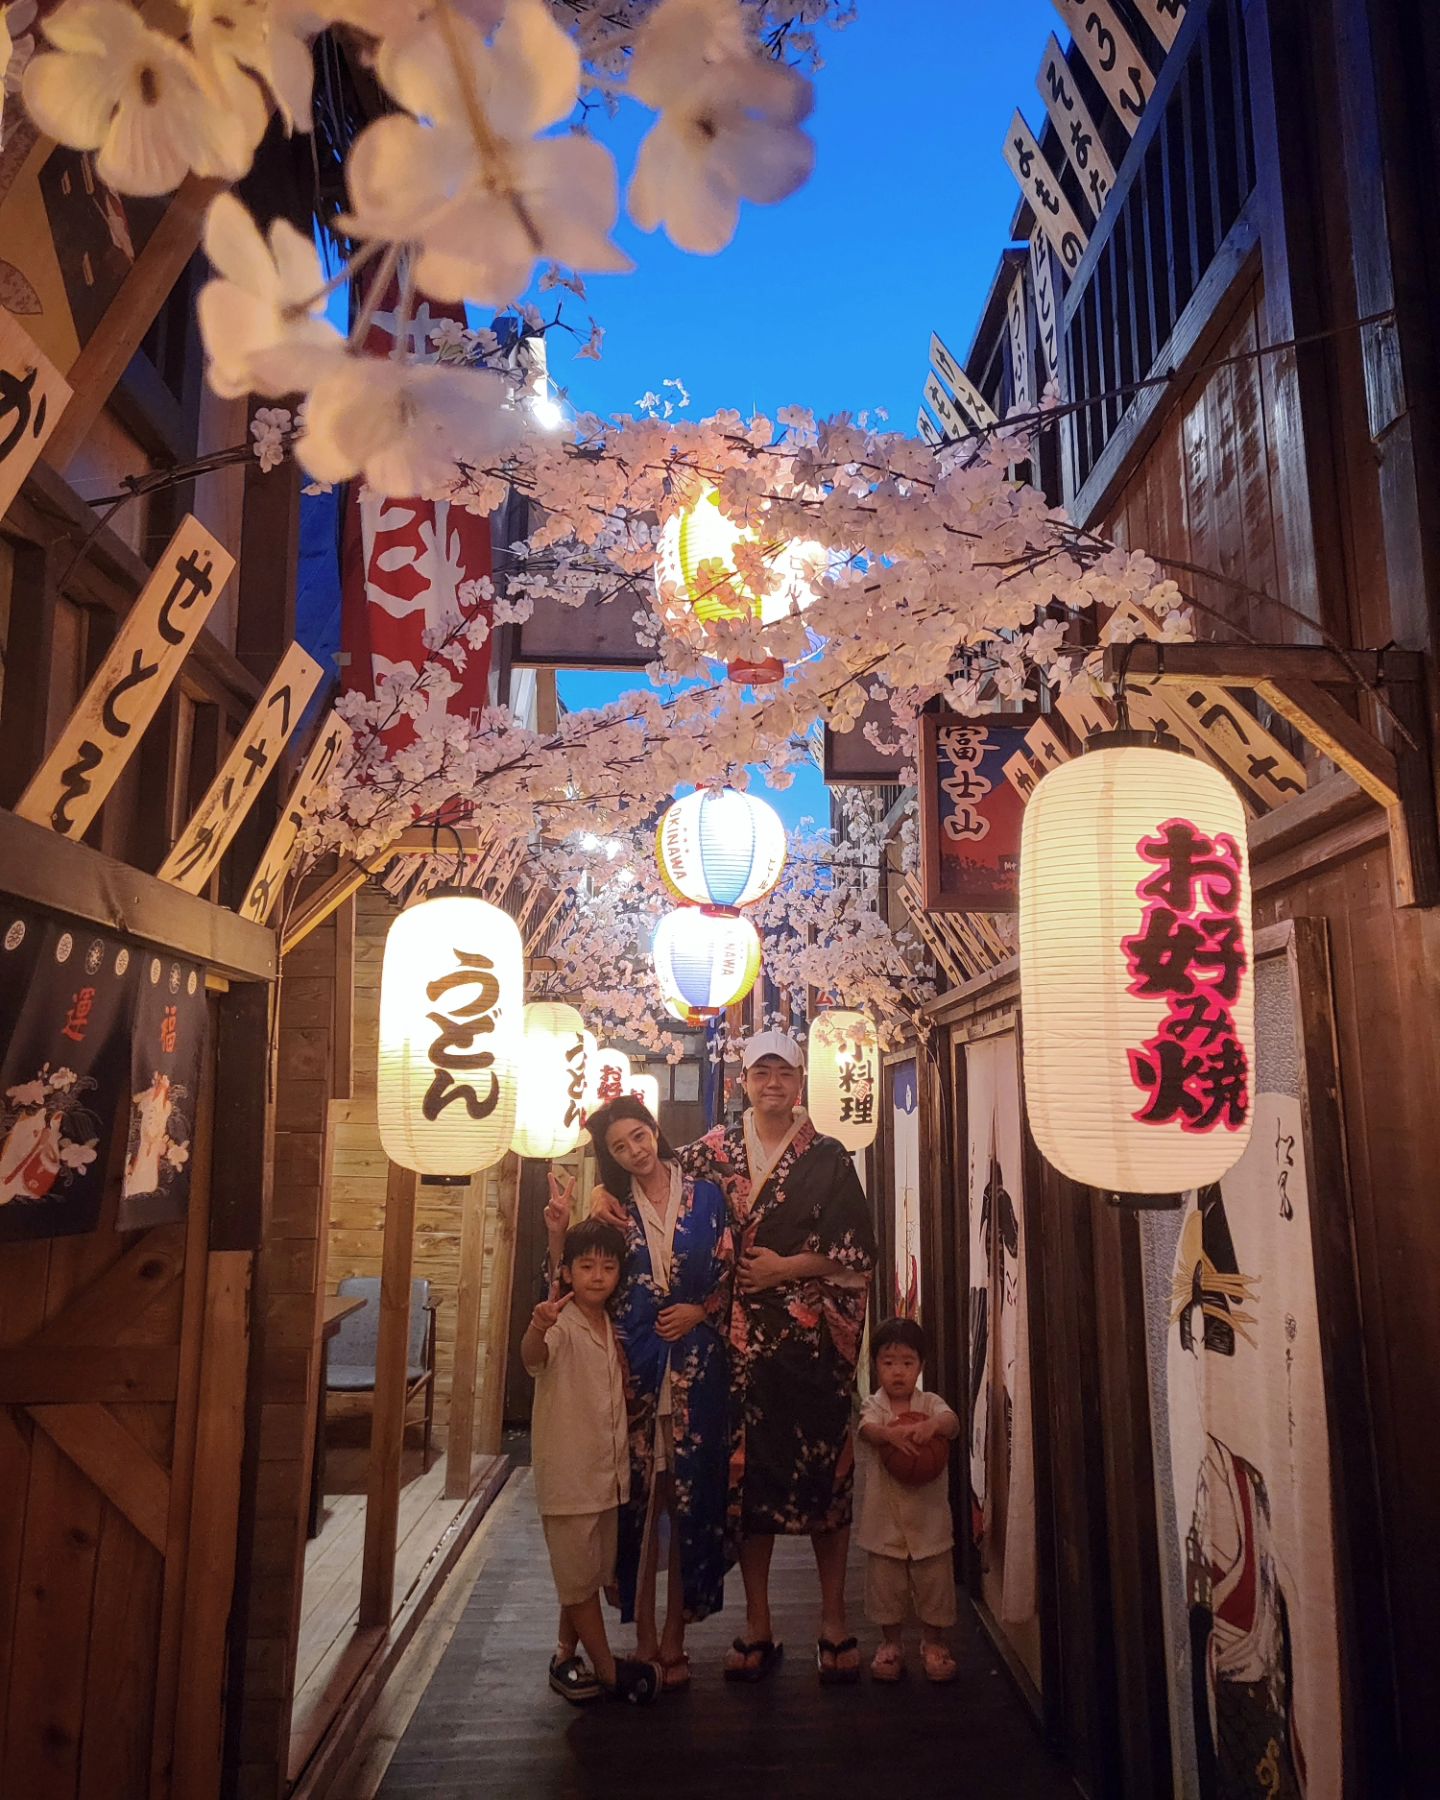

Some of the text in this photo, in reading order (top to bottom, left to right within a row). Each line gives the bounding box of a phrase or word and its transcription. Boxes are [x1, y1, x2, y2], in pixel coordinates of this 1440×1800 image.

[1066, 0, 1147, 117] ろひ
[51, 549, 213, 834] せとそ
[666, 806, 688, 881] OKINAWA
[946, 726, 985, 836] 富士山
[422, 947, 502, 1121] うどん
[1127, 822, 1248, 1129] お好み焼
